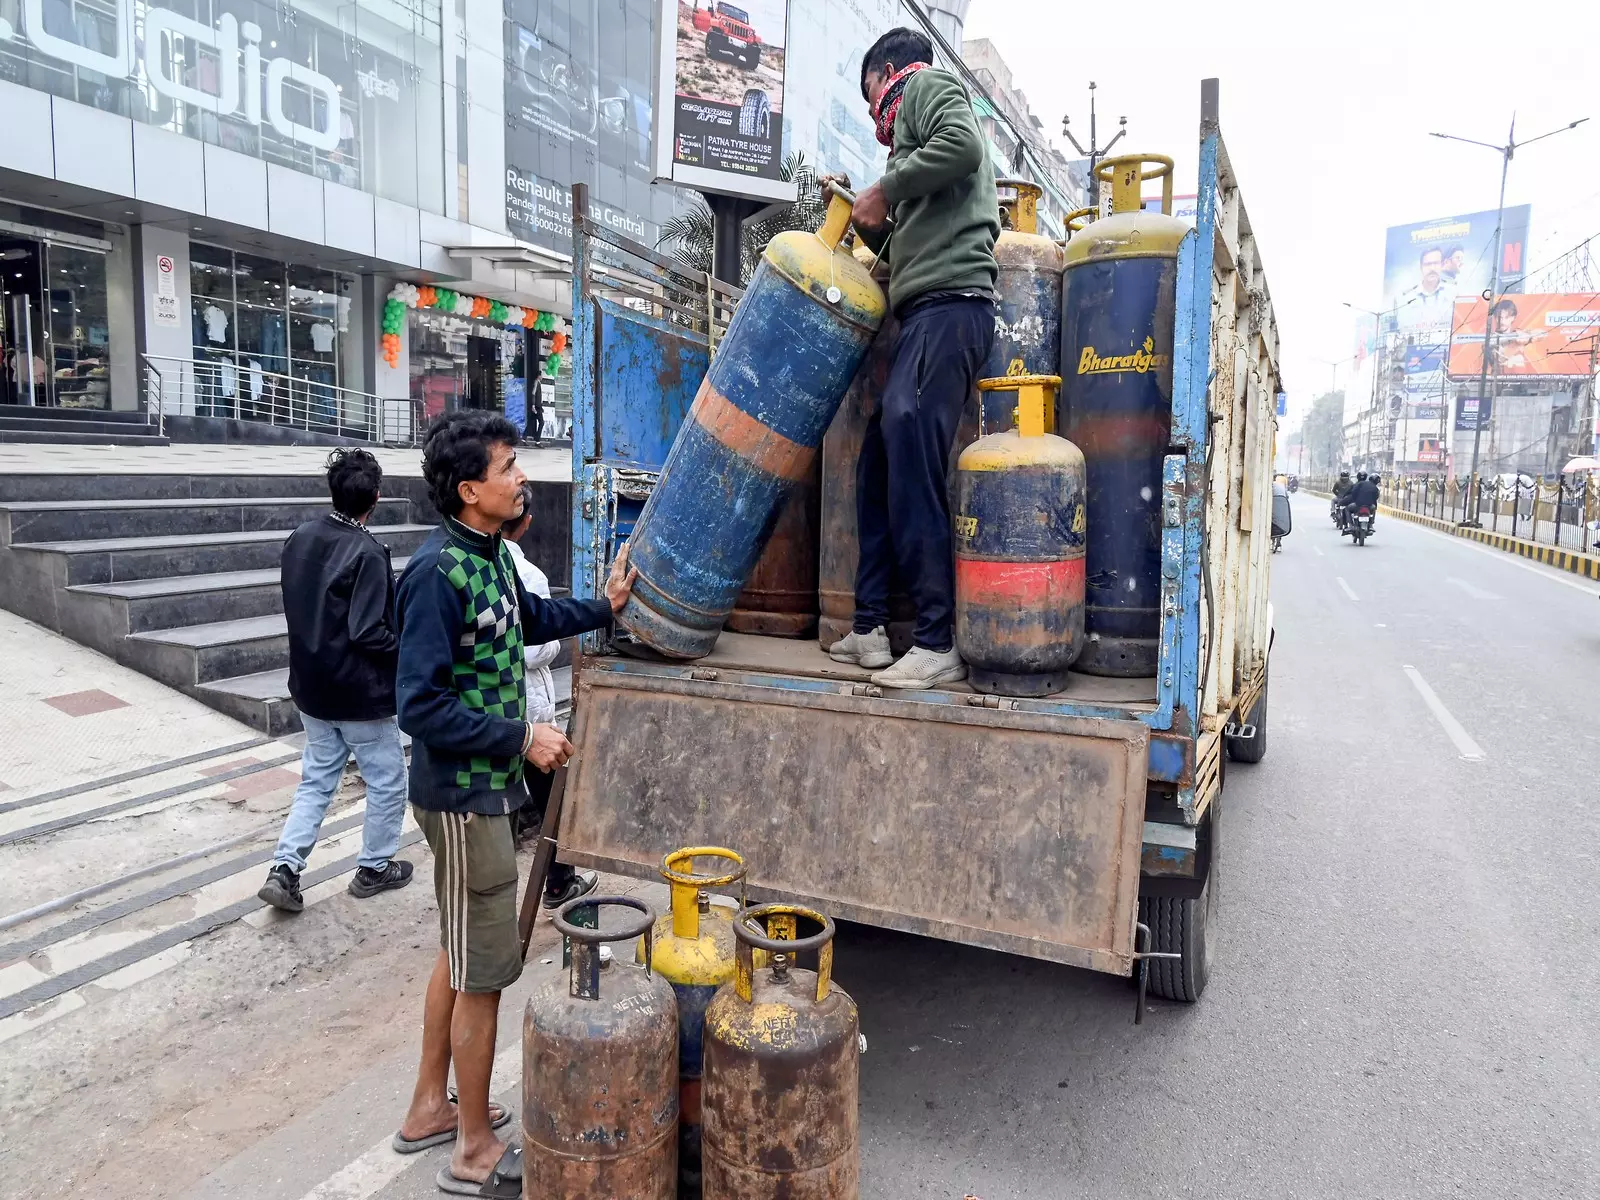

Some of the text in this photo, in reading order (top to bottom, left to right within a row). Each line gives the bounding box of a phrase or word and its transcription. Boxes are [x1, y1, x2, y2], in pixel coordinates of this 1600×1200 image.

[0, 0, 340, 151] udio
[708, 135, 730, 147] PATNA
[730, 138, 748, 150] TYRE
[749, 142, 772, 154] HOUSE
[506, 169, 645, 237] Renault Pna Central
[506, 192, 537, 213] Pandey
[538, 203, 561, 221] Plaza,
[506, 207, 522, 221] Tel.
[1078, 346, 1168, 374] Bharatgas
